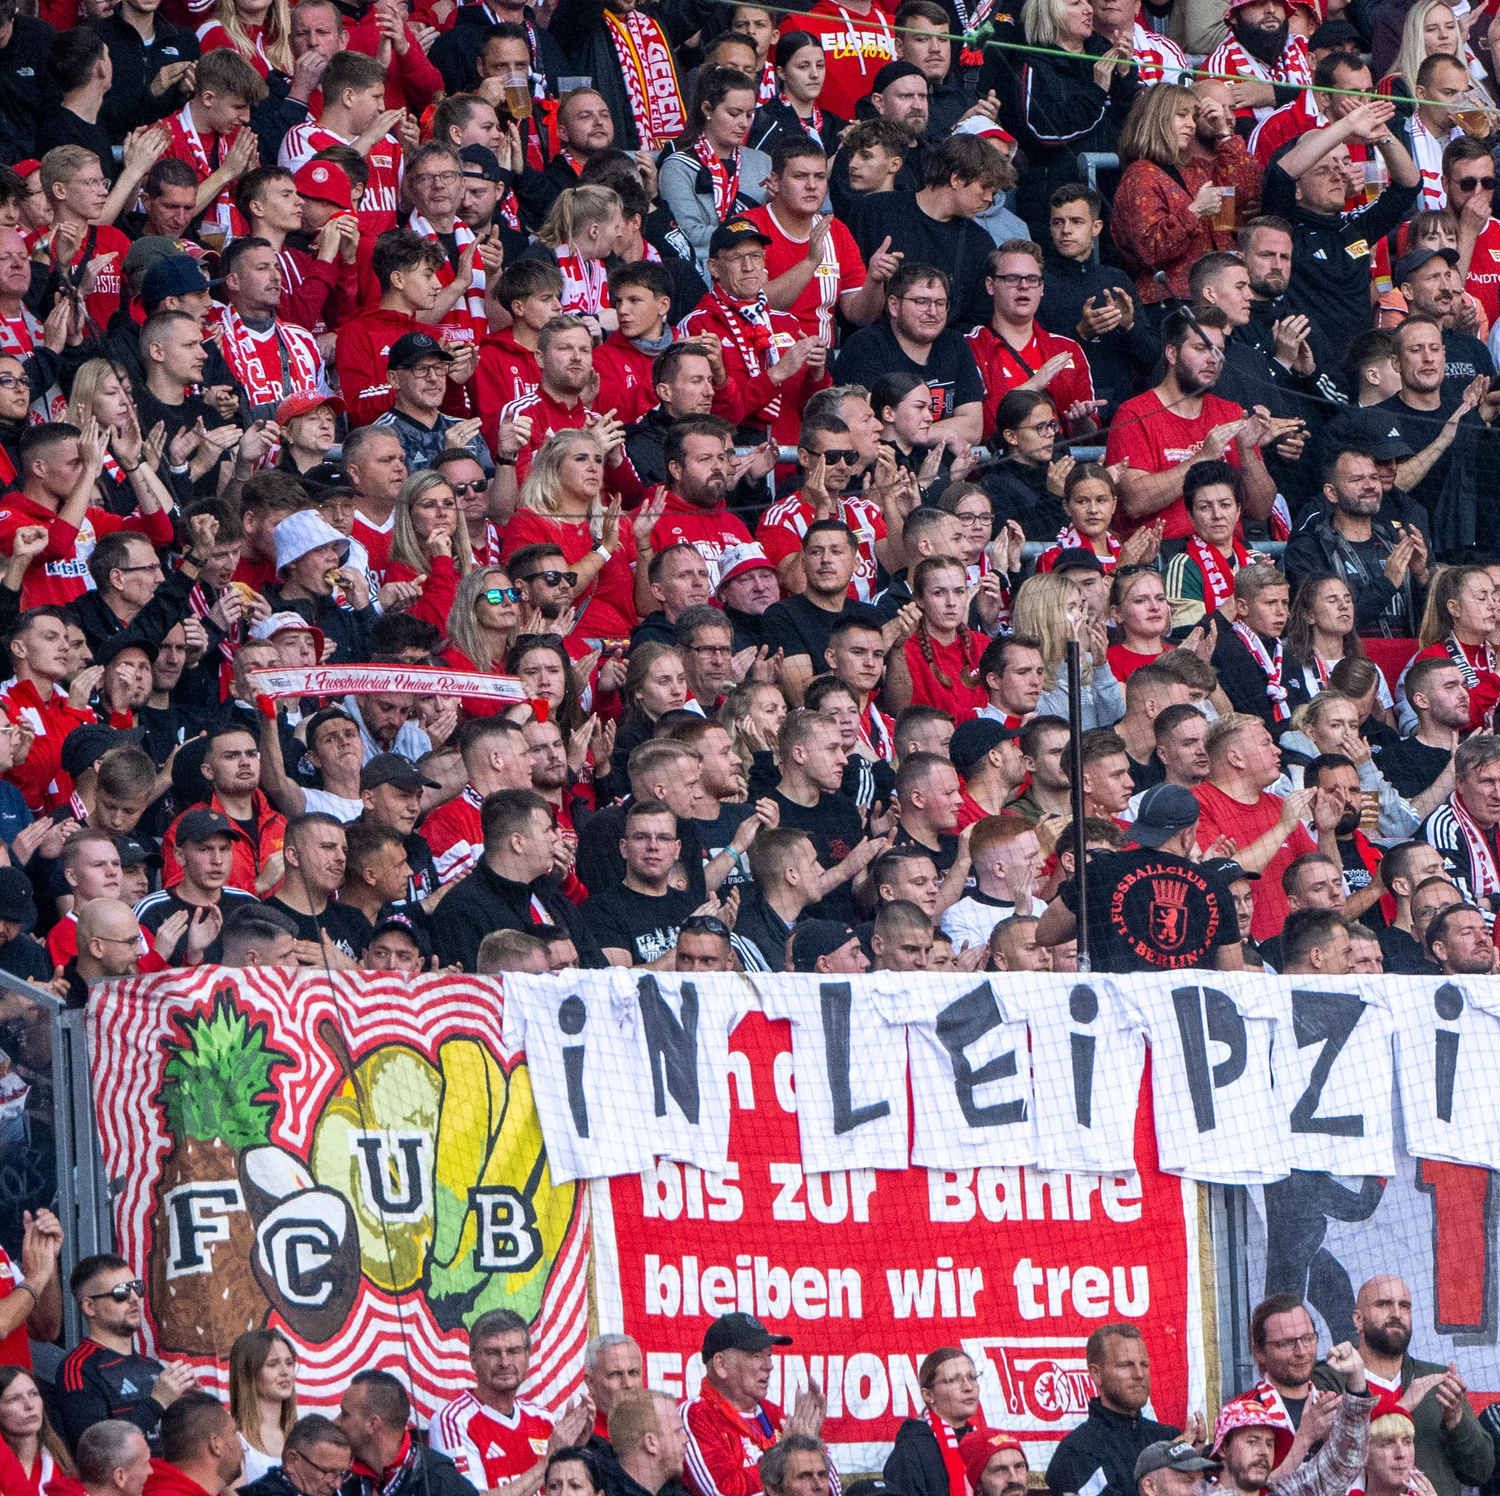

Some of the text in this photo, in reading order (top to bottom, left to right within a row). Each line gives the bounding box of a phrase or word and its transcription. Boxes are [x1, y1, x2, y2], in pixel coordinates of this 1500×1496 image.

[359, 184, 397, 212] RLIN
[1133, 943, 1198, 969] BERLIN
[642, 1157, 744, 1222] bis
[770, 1163, 878, 1225] zur
[645, 1255, 1150, 1319] bleiben wir treu
